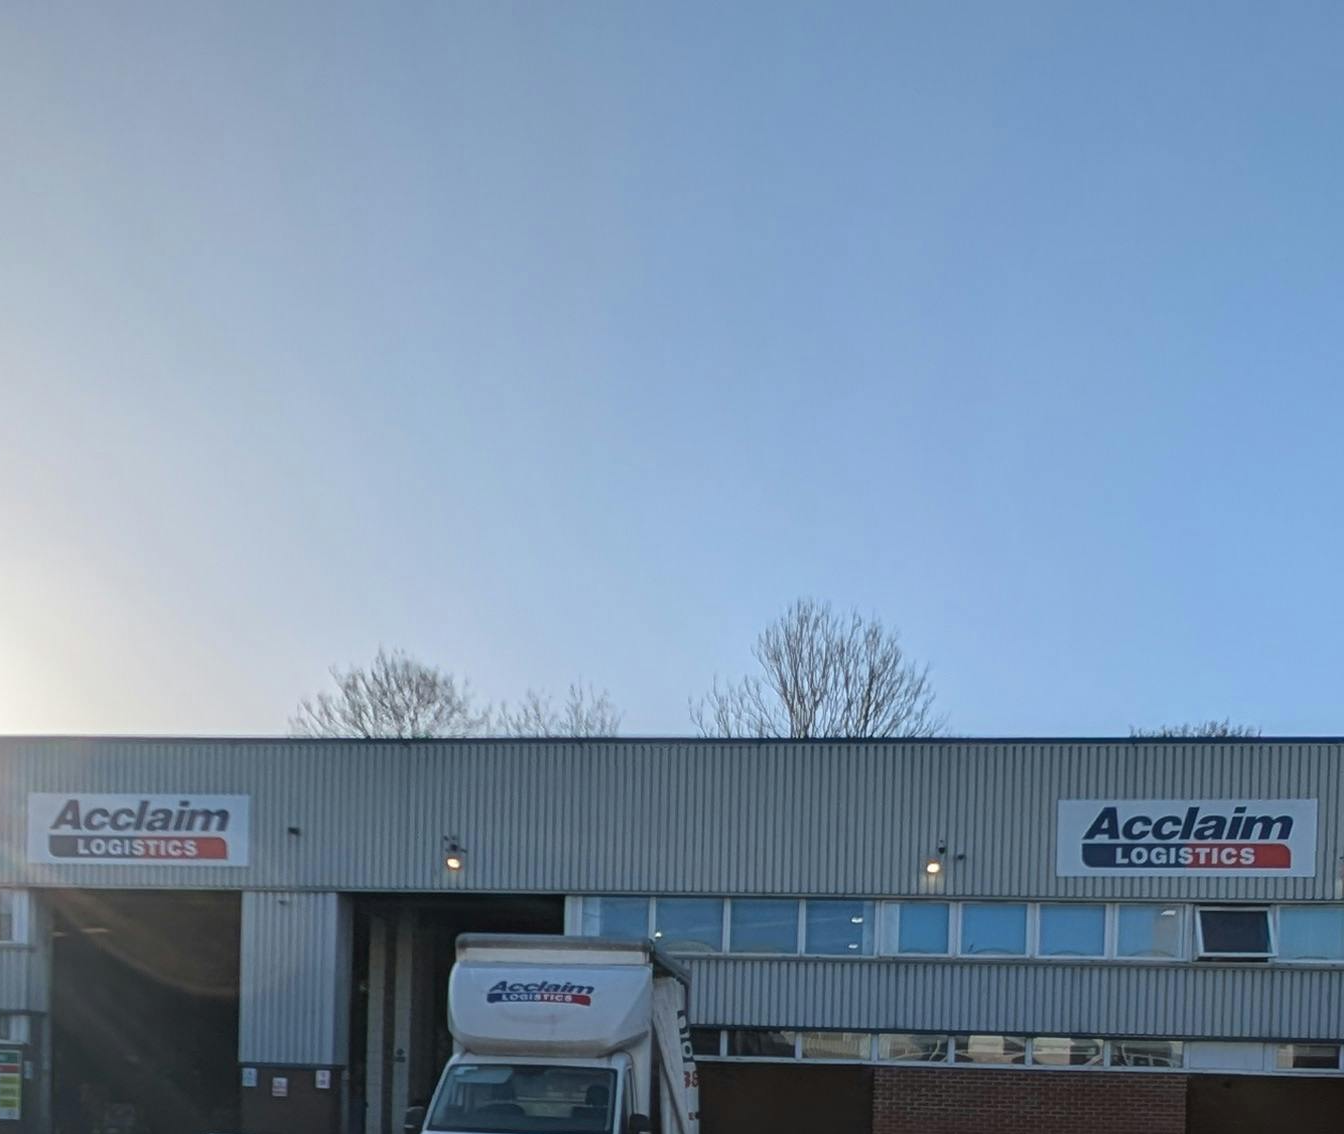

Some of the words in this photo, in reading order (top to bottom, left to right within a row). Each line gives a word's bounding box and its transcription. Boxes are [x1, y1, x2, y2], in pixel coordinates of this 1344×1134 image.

[50, 800, 229, 832] Acclaim
[1082, 807, 1294, 840] Acclaim
[77, 838, 198, 856] LOGISTICS
[1115, 847, 1256, 864] LOGISTICS
[489, 981, 595, 994] Acclaim
[501, 993, 573, 1002] LOGISTICS
